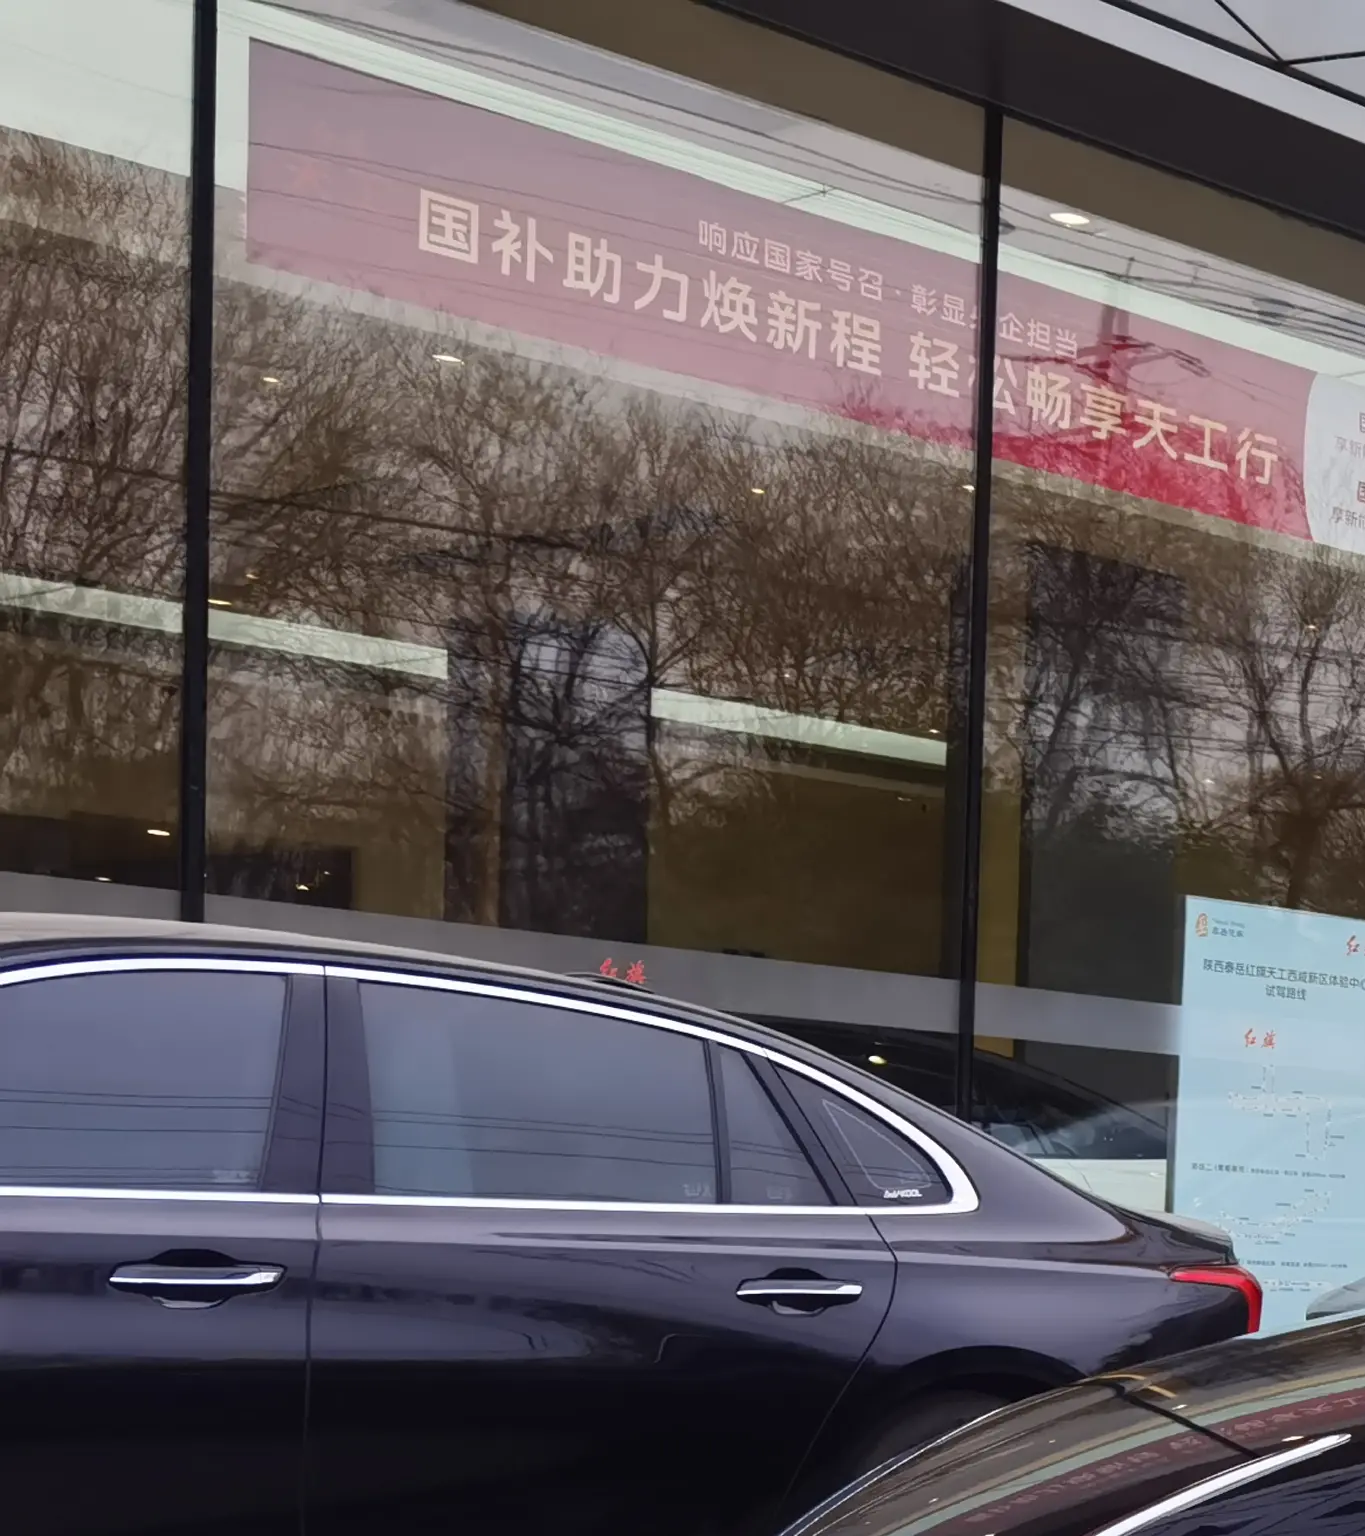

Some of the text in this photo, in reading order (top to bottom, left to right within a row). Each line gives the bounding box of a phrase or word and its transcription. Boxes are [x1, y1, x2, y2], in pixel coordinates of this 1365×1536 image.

[418, 188, 882, 377] 国补助力焕新程
[699, 219, 1079, 360] 响应国家号召·彰显企担当
[1265, 984, 1308, 1001] 试驾路线
